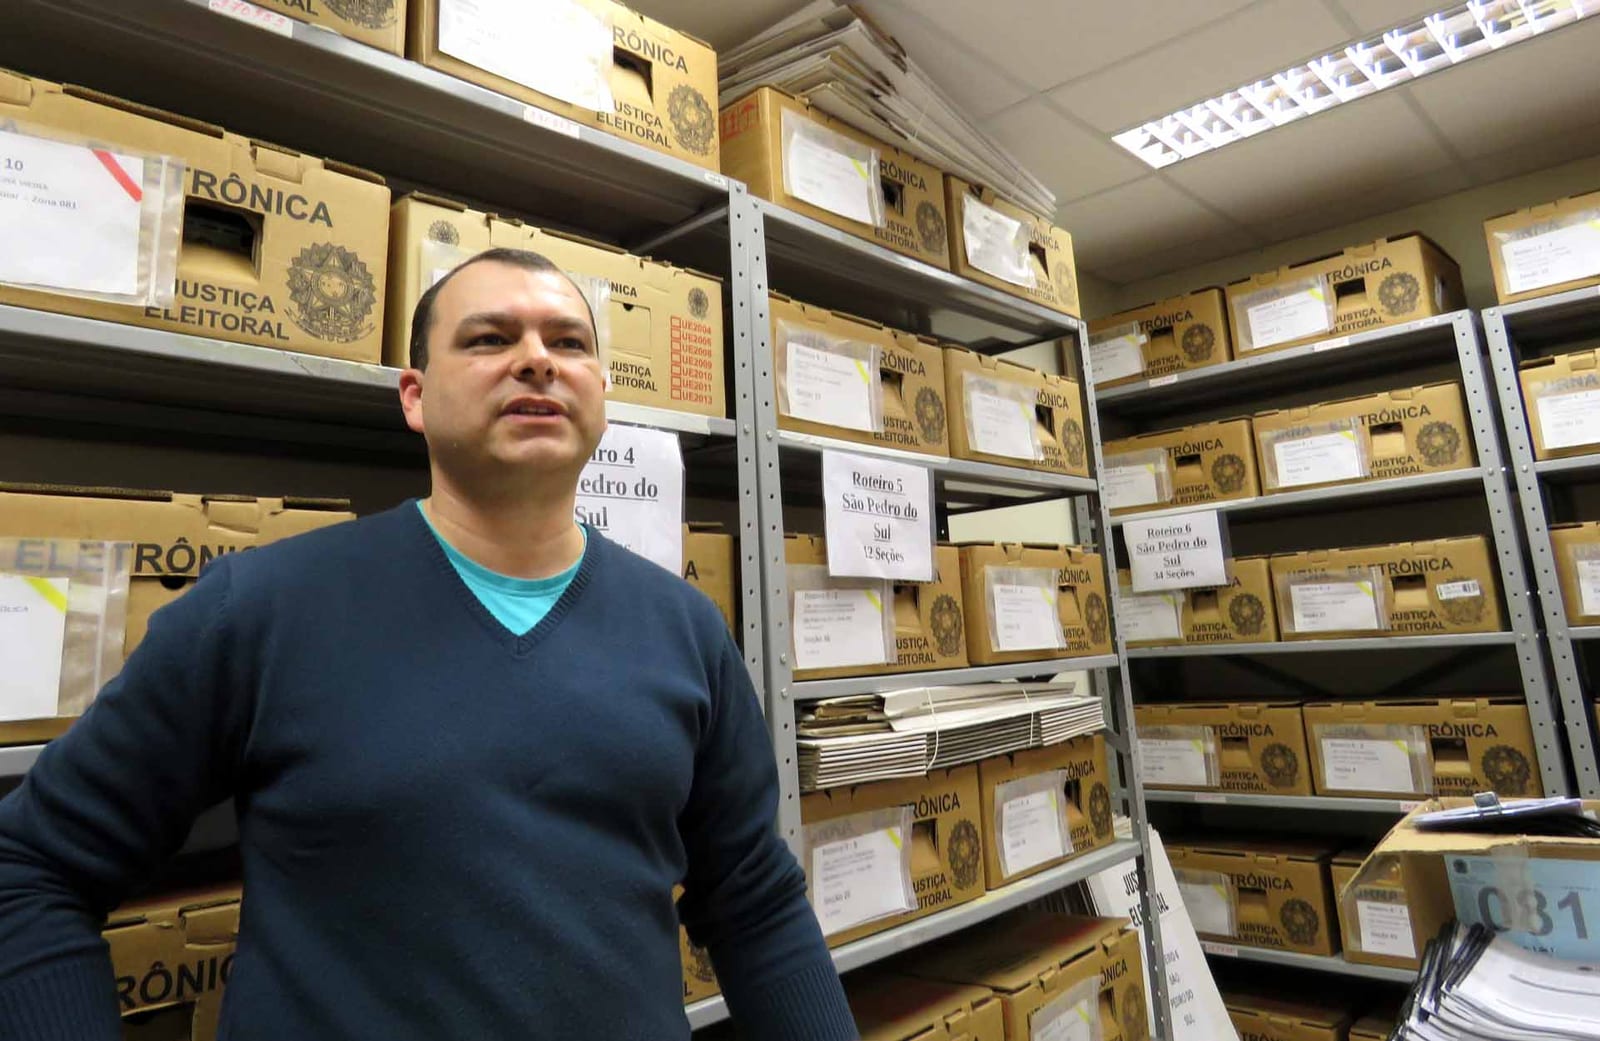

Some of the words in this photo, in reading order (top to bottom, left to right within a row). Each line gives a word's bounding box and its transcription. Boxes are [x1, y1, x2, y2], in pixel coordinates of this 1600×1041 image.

[596, 112, 672, 149] ELEITORAL
[172, 279, 276, 314] JUSTIÇA
[610, 280, 638, 299] NICA
[144, 305, 290, 341] ELEITORAL
[1334, 306, 1377, 325] JUSTIÇA
[609, 360, 651, 379] JUSTIÇA
[1358, 403, 1431, 428] TRÔNICA
[623, 447, 635, 464] 4
[1166, 437, 1224, 458] TRÔNICA
[1369, 454, 1416, 470] JUSTIÇA
[580, 473, 627, 496] edro
[634, 477, 658, 498] do
[852, 471, 894, 491] Roteiro
[896, 478, 903, 493] 5
[842, 493, 864, 511] São
[867, 496, 901, 516] Pedro
[904, 501, 918, 519] do
[575, 506, 609, 528] Sul
[873, 521, 891, 541] Sul
[1147, 525, 1183, 539] Roteiro
[1185, 522, 1192, 533] 6
[863, 545, 873, 560] 12
[875, 547, 905, 564] Seções
[1136, 541, 1155, 554] São
[1158, 538, 1190, 552] Pedro
[1193, 536, 1207, 548] do
[1163, 553, 1181, 567] Sul
[1166, 568, 1195, 580] Seções
[1391, 610, 1436, 623] JUSTIÇA
[895, 636, 929, 652] USTIÇA
[897, 650, 936, 666] EITORAL
[1212, 721, 1274, 738] TRÔNICA
[1065, 758, 1095, 782] ÔNICA
[1217, 780, 1268, 792] LEITORAL
[1478, 886, 1588, 940] 081
